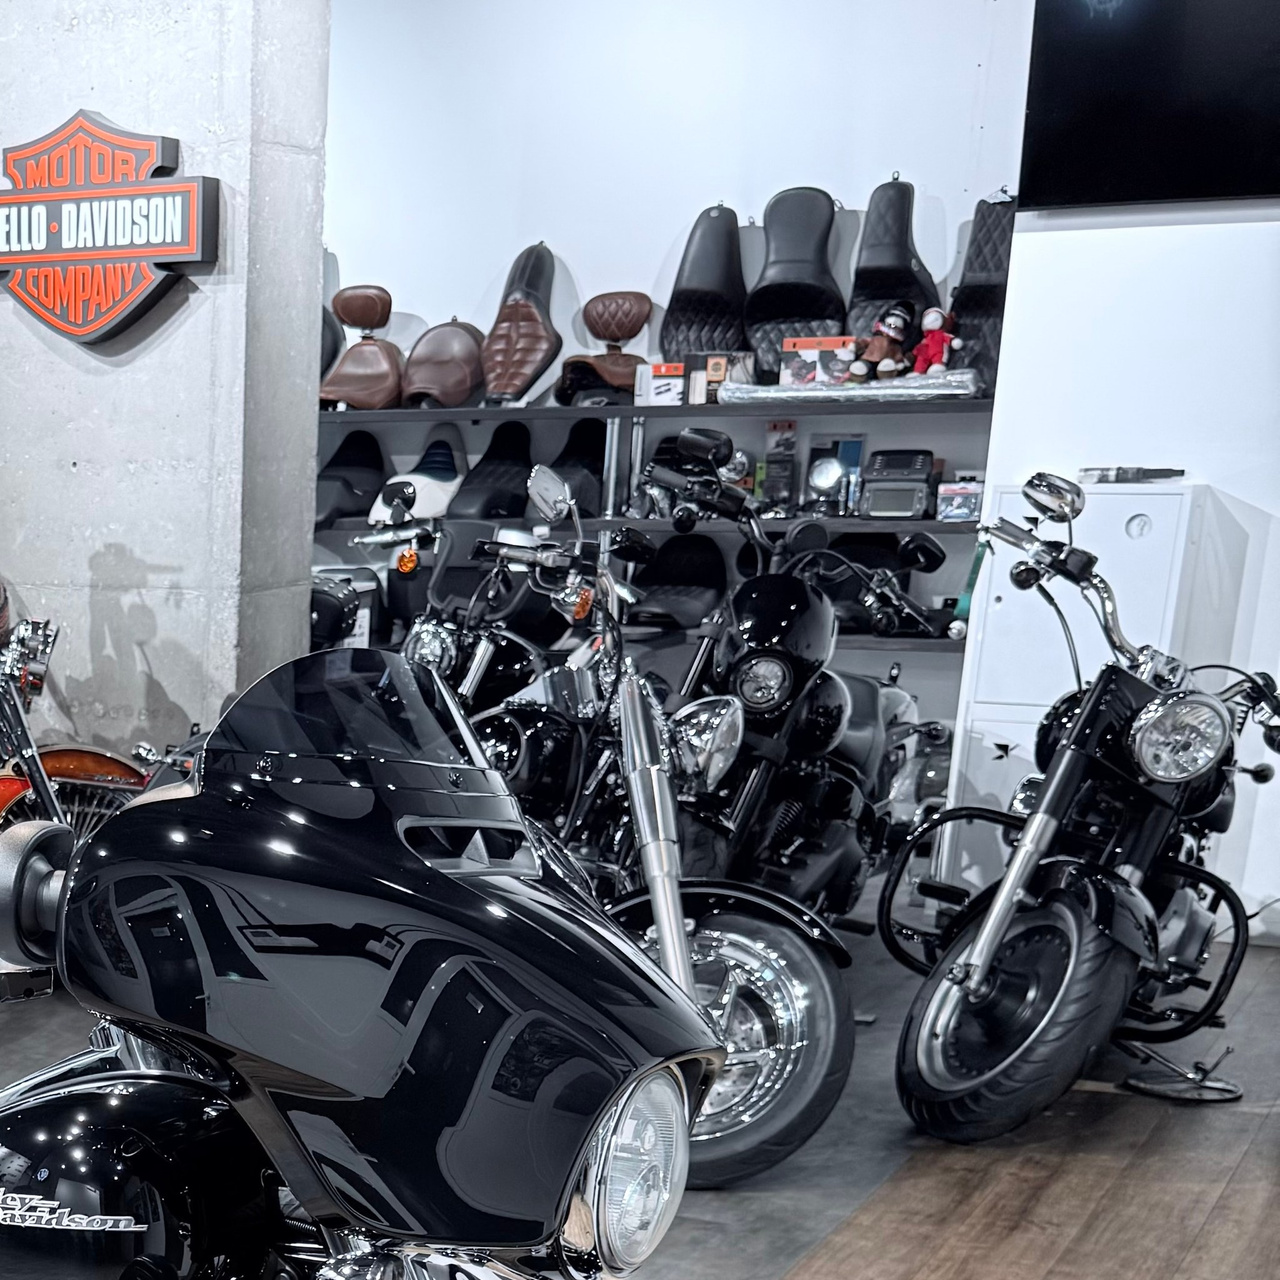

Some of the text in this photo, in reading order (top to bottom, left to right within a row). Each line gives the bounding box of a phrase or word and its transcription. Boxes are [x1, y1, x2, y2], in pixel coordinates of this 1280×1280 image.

[26, 132, 136, 189] MOTOR
[61, 195, 182, 249] DAVIDSON
[25, 262, 137, 324] COMPANY
